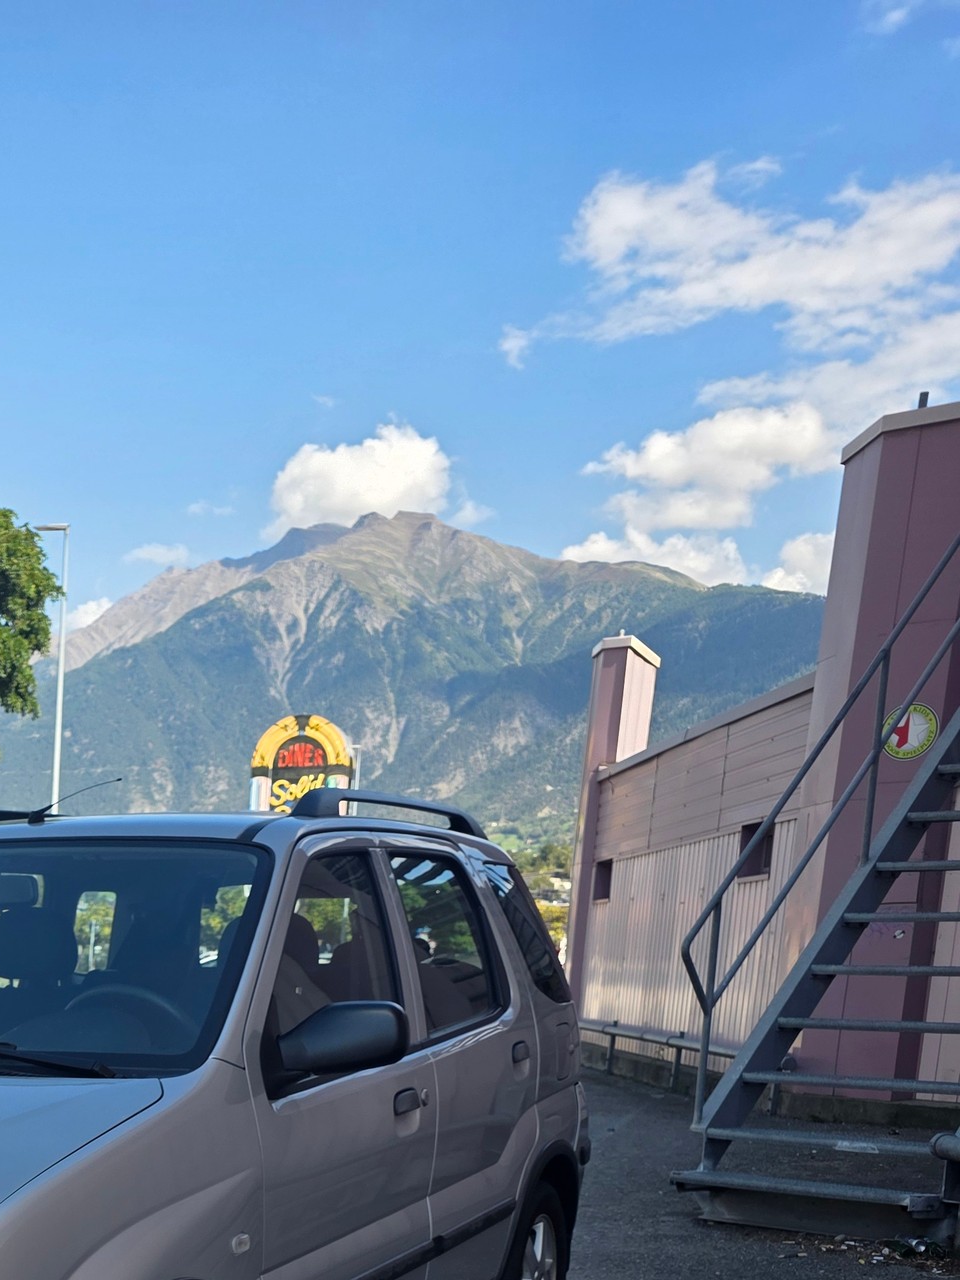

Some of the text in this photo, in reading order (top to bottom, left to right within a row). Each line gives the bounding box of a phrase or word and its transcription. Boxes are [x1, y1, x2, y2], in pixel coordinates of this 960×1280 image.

[912, 706, 930, 718] KIDS
[277, 743, 324, 768] DINER
[269, 773, 325, 806] Solid
